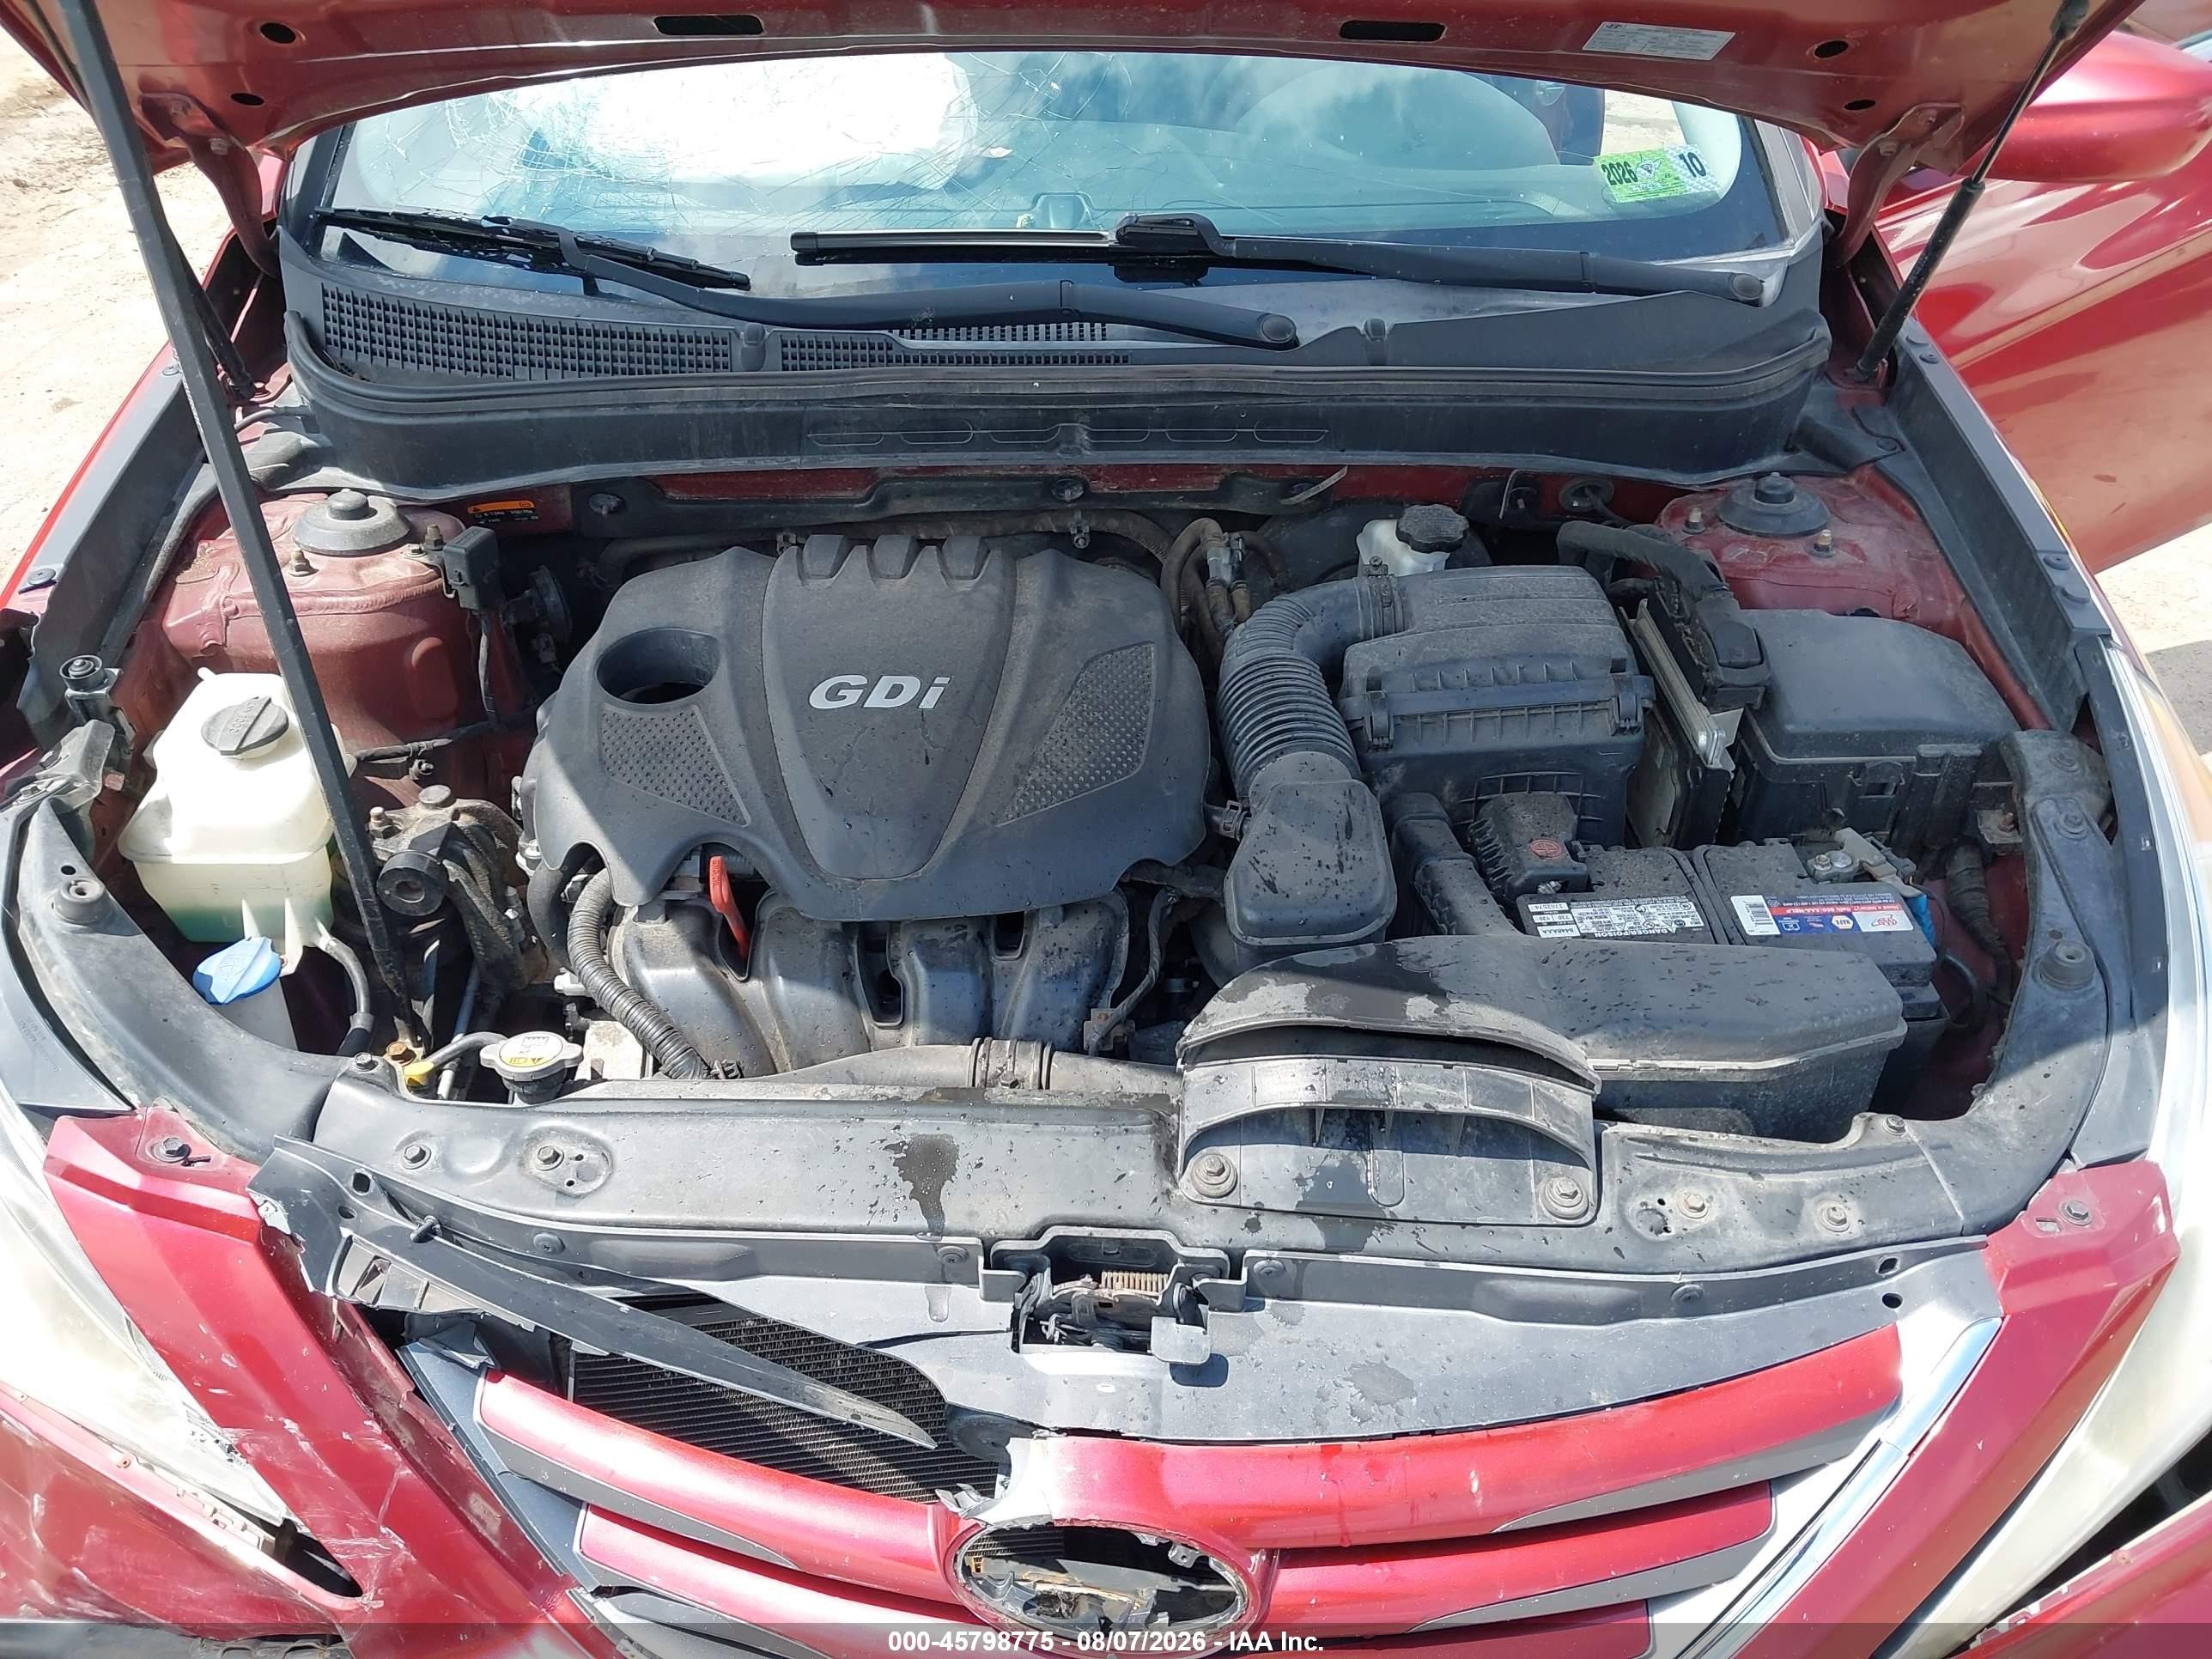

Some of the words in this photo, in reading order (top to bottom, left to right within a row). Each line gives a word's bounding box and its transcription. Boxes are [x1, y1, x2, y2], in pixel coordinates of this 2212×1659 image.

[1601, 161, 1638, 185] 2026
[1678, 151, 1707, 178] 10
[808, 673, 951, 710] GDi
